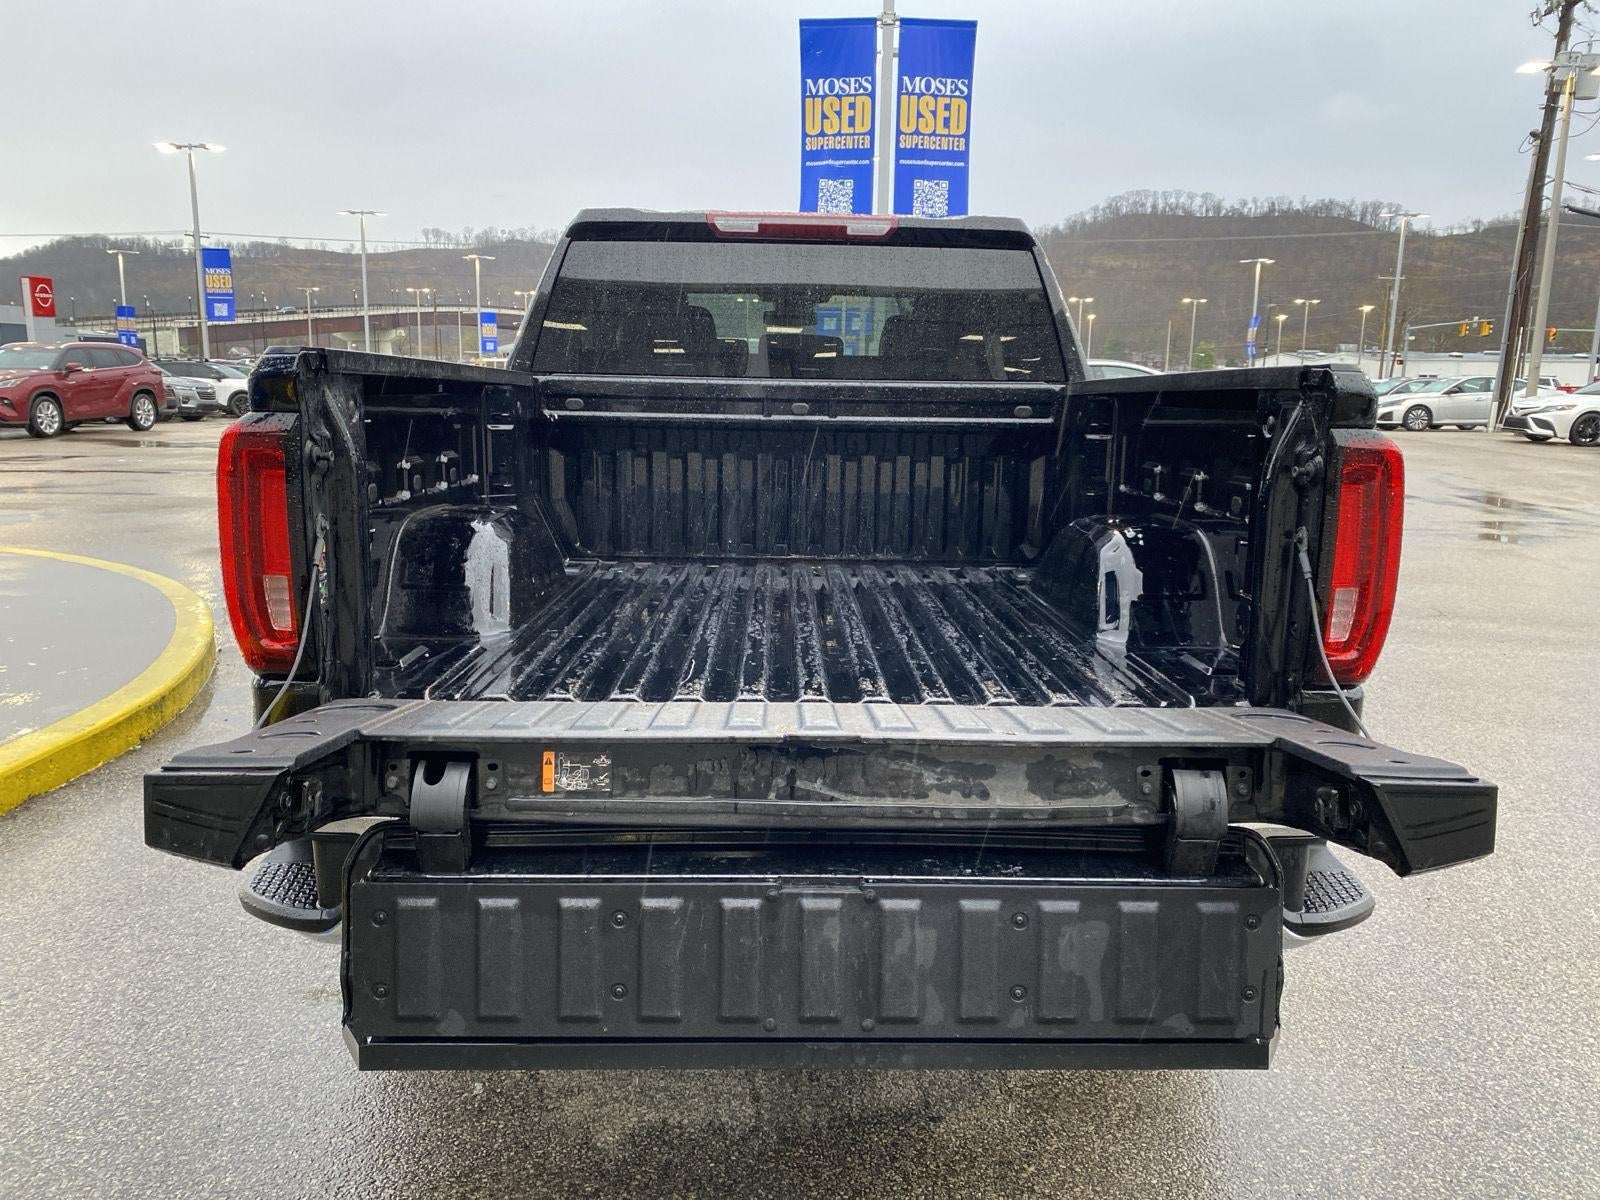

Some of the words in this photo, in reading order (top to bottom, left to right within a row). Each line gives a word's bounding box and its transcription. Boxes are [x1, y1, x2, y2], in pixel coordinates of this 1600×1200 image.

[806, 76, 872, 96] MOSES
[902, 76, 968, 96] MOSES
[805, 96, 871, 135] USED
[900, 96, 967, 135] USED
[806, 135, 870, 151] SUPERCENTER
[899, 135, 966, 151] SUPERCENTER
[206, 275, 232, 288] USED
